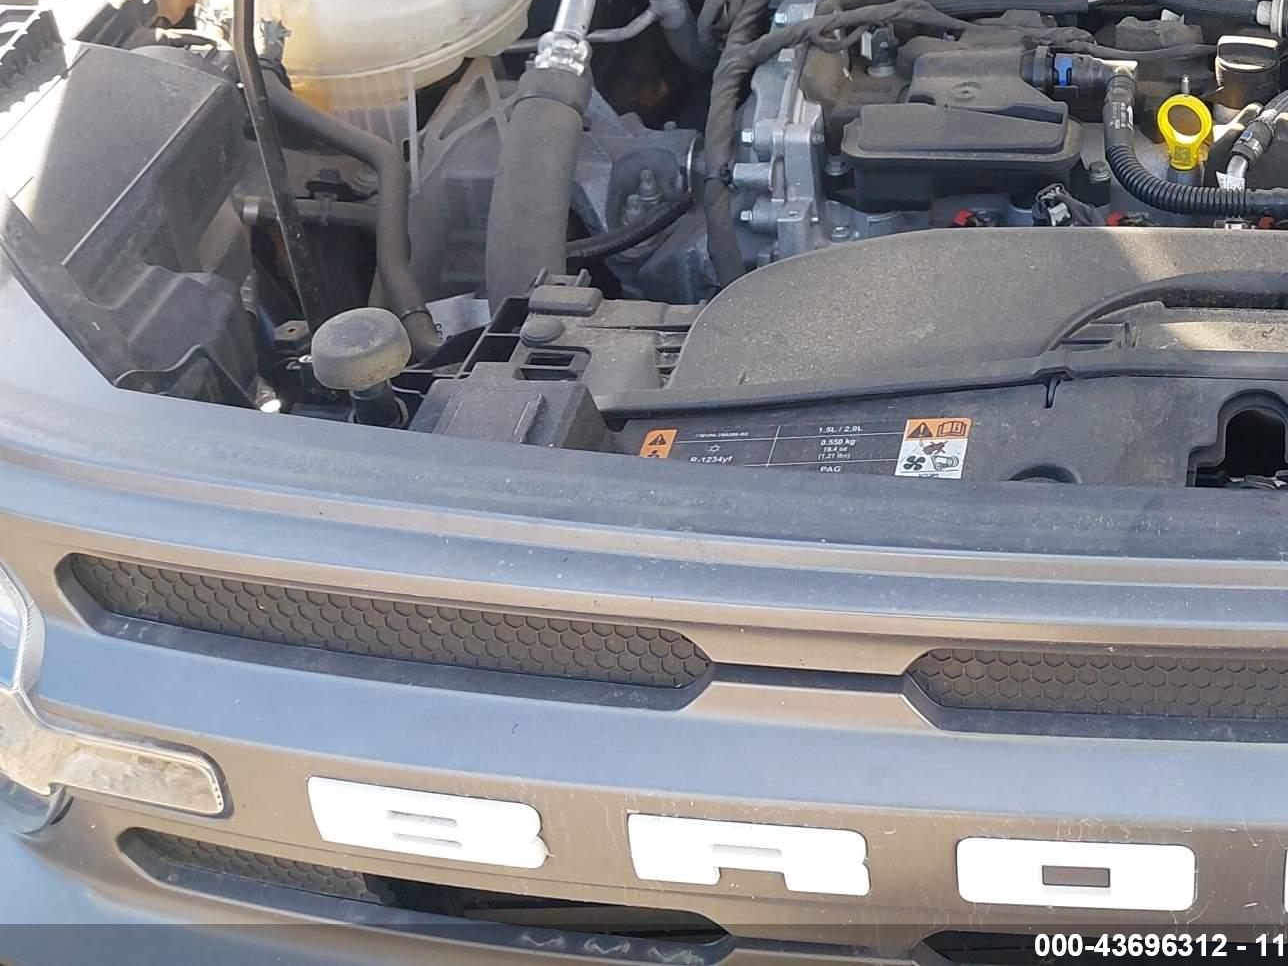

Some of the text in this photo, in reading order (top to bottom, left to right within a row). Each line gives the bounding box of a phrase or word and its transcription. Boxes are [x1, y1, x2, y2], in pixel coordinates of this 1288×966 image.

[819, 426, 837, 434] 1.5L
[843, 425, 863, 433] 2.0L
[820, 438, 856, 446] 0.550 kg
[820, 465, 842, 473] PAG
